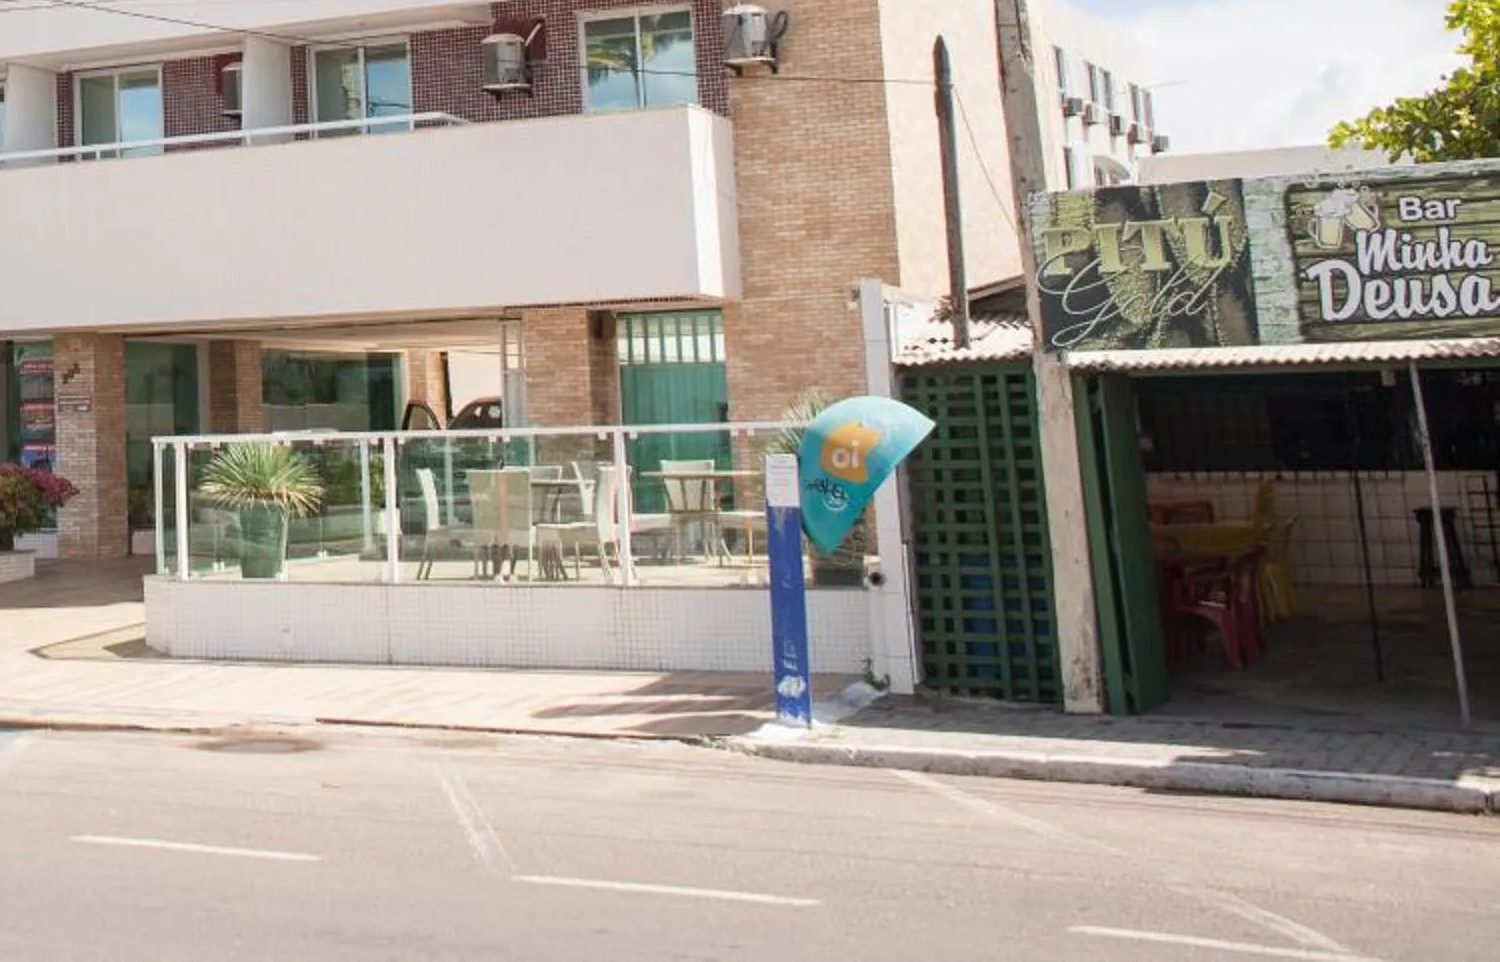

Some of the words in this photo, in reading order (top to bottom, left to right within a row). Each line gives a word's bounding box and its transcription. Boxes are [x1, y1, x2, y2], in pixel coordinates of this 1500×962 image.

[1399, 196, 1462, 221] Bar
[1355, 225, 1493, 275] Minha
[1036, 250, 1232, 347] Gold
[1304, 258, 1500, 322] Deusa
[831, 439, 861, 469] oi
